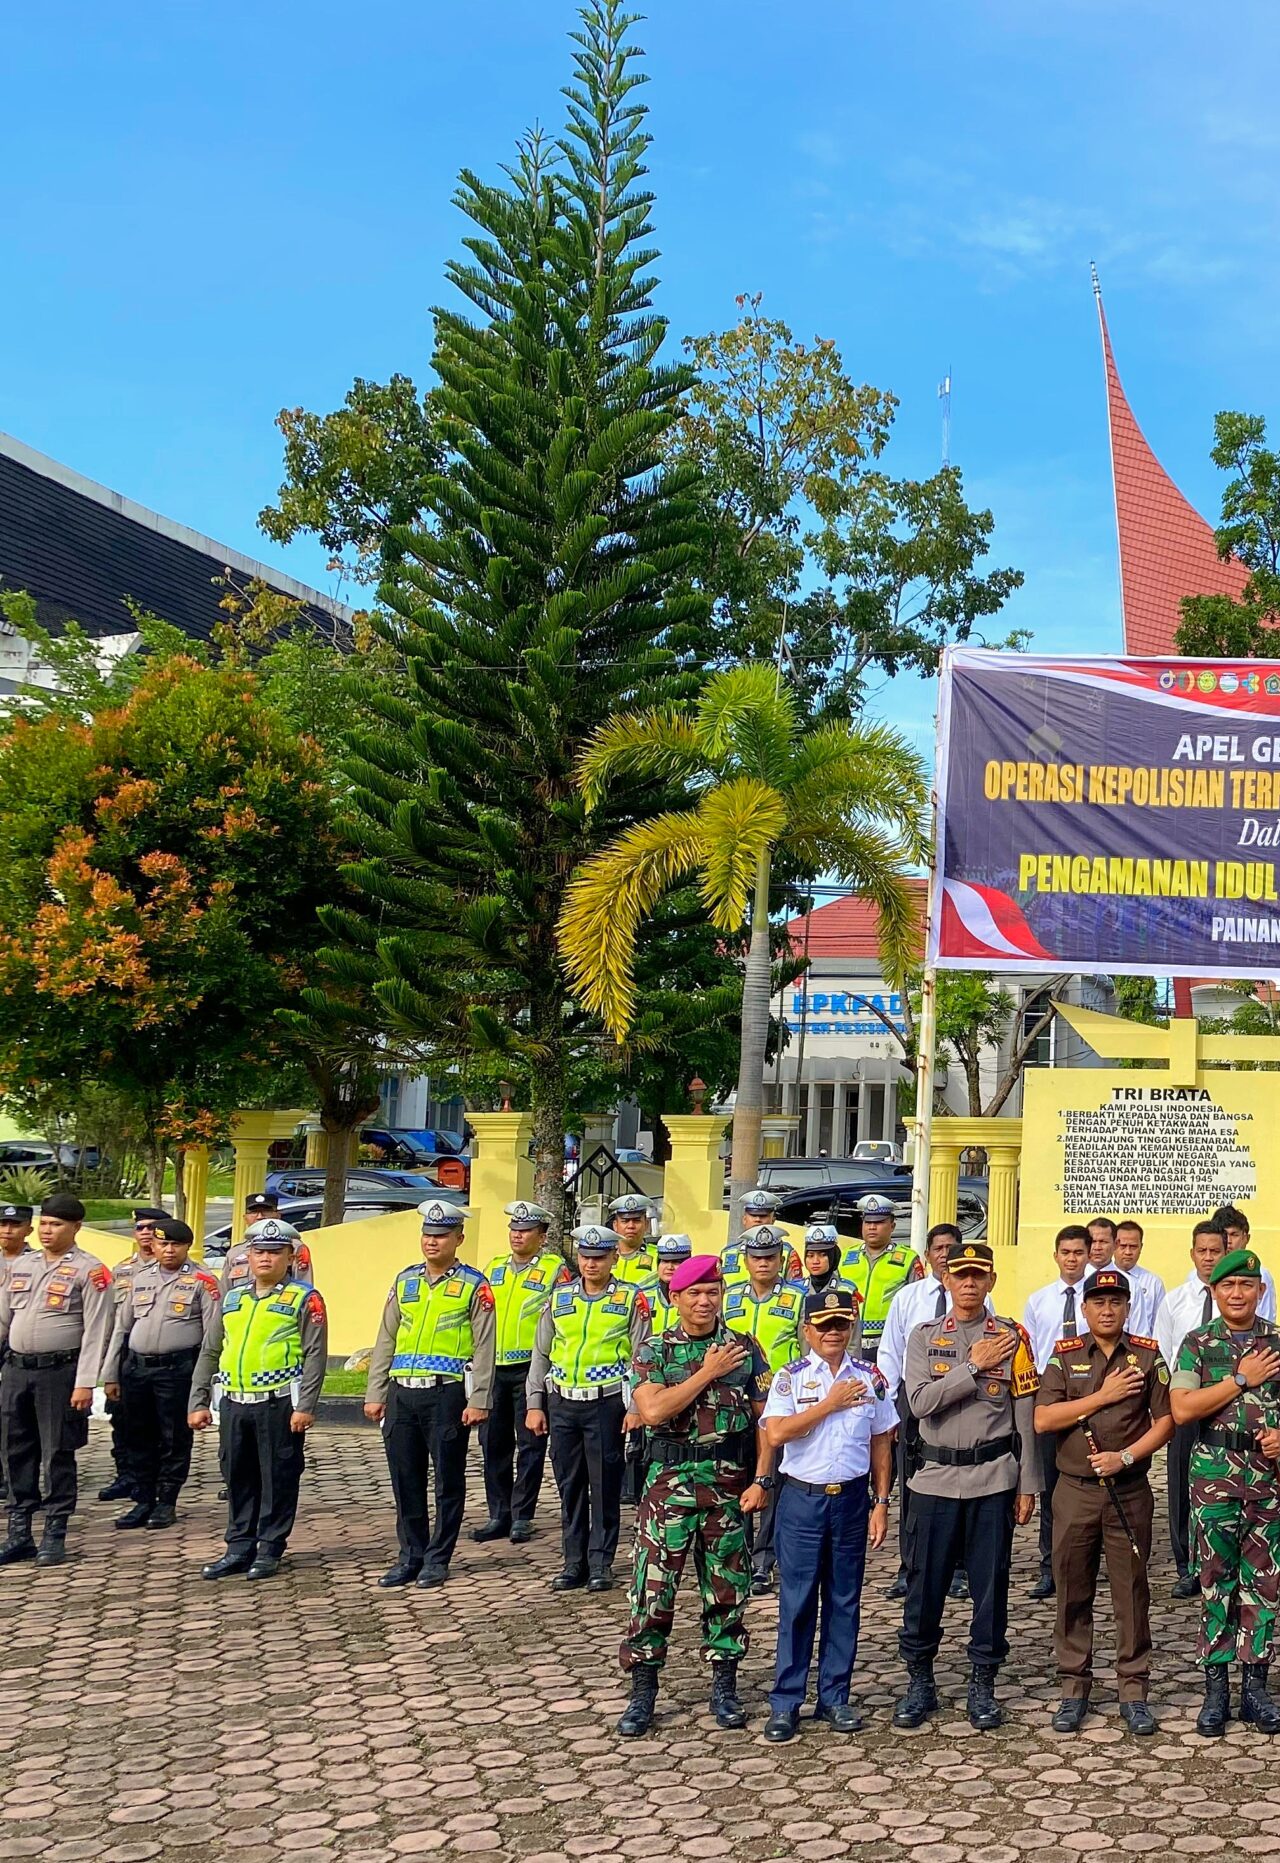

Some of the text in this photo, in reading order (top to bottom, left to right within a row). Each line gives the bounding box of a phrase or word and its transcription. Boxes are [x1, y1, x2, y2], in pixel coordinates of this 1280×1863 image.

[1172, 735, 1244, 761] APEL
[984, 760, 1084, 803] OPERASI
[1089, 766, 1224, 808] KEPOLISIAN
[1018, 854, 1209, 898] PENGAMANAN
[1215, 861, 1277, 900] IDUL
[1112, 1088, 1212, 1102] TRI BRATA
[1100, 1104, 1224, 1113] KAMI POLISI INDONESIA
[1119, 1112, 1157, 1120] KEPADA
[1190, 1113, 1210, 1121] DAN
[1066, 1118, 1107, 1126] DENGAN
[1147, 1120, 1209, 1128] KETAKWAAN
[1066, 1126, 1119, 1134] TERHADAP
[1121, 1127, 1156, 1135] TUHAN
[1189, 1128, 1217, 1136] MAHA
[1137, 1136, 1172, 1144] TINGGI
[1175, 1137, 1236, 1145] KEBENARAN
[1065, 1143, 1114, 1151] KEADILAN
[1141, 1144, 1213, 1152] KEMANUSIAAN
[1065, 1151, 1134, 1159] MENEGAKKAN
[1178, 1152, 1218, 1160] NEGARA
[1172, 1160, 1226, 1168] INDONESIA
[1141, 1167, 1196, 1175] PANCASILA
[602, 1304, 627, 1315] POLISI
[769, 1308, 794, 1319] POLISI
